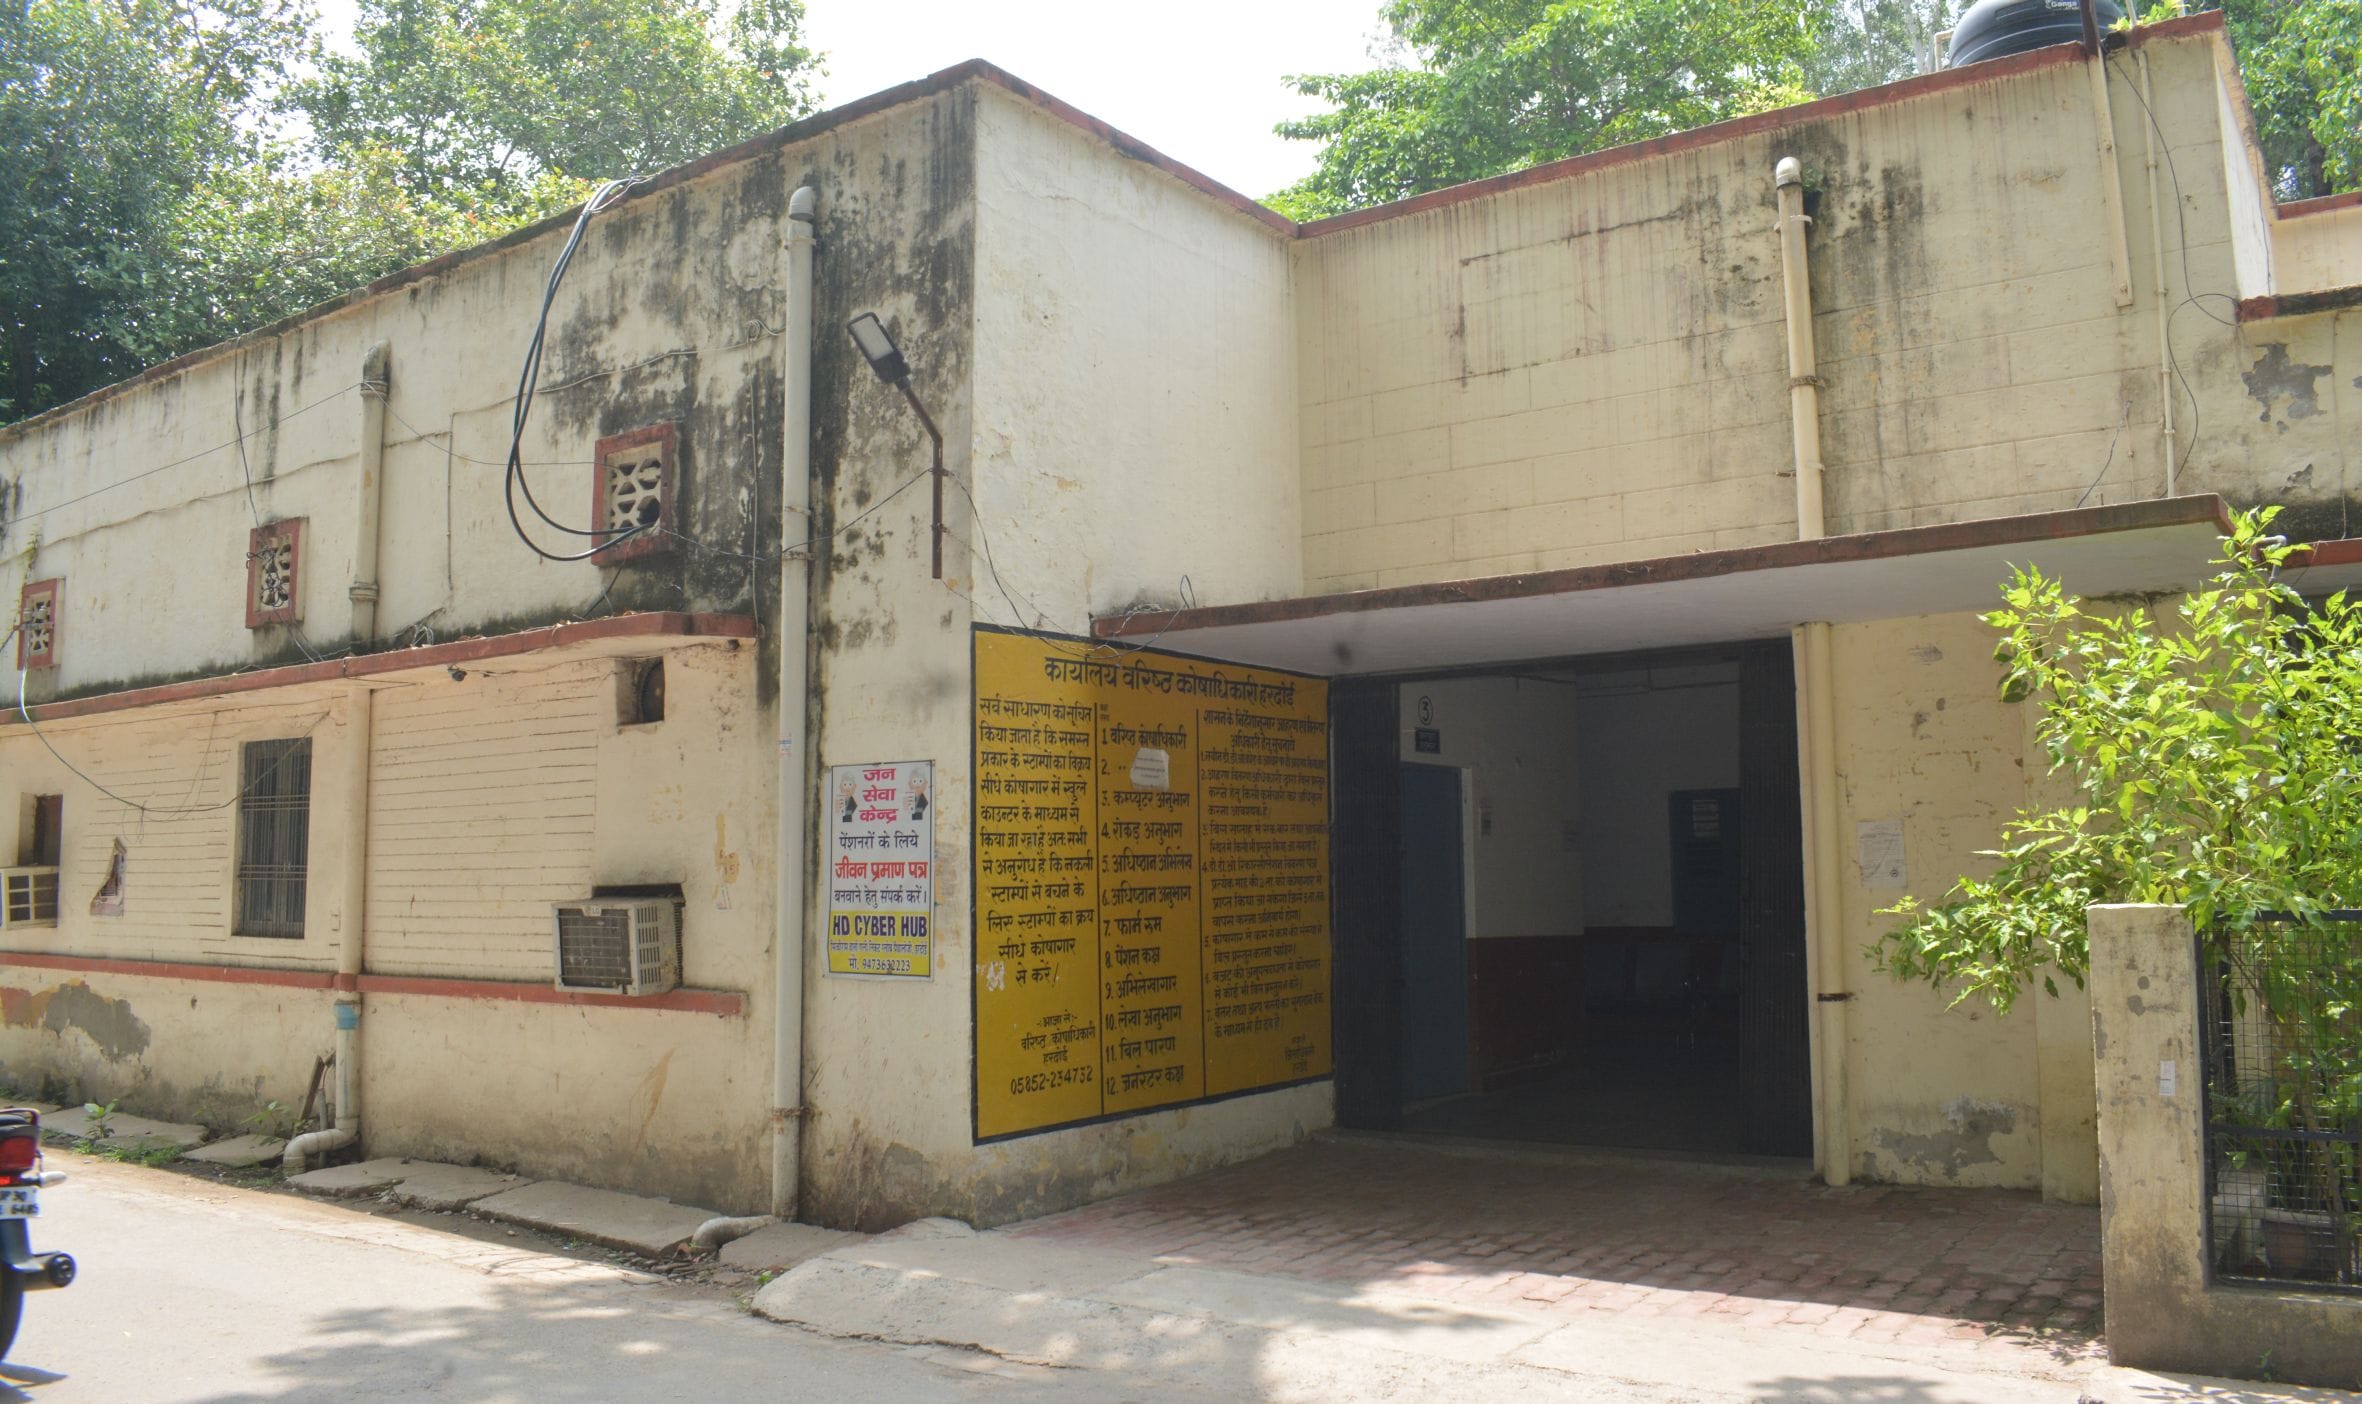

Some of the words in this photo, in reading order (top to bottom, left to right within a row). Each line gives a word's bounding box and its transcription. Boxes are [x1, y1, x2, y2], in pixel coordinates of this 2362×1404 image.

[1045, 654, 1120, 687] कार्यालय
[1176, 665, 1258, 705] कोषाधिकारी
[980, 693, 1001, 715] सर्व
[1003, 700, 1051, 720] साधारण
[1052, 698, 1064, 720] को
[980, 720, 1007, 742] किया
[1009, 728, 1030, 744] जाता
[1032, 721, 1040, 748] है
[1044, 724, 1057, 745] कि
[981, 750, 1008, 767] प्रकार
[1010, 748, 1020, 767] के
[1053, 756, 1065, 770] का
[863, 765, 896, 782] जन
[1004, 774, 1048, 796] कोषागार
[1051, 774, 1060, 796] में
[863, 785, 896, 802] सेवा
[859, 806, 898, 823] केन्द्र
[981, 806, 1019, 823] काउन्टर
[1021, 800, 1032, 821] के
[1035, 807, 1069, 821] माध्यम
[1071, 803, 1079, 823] से
[839, 832, 875, 851] पेंशनरों
[879, 831, 890, 849] के
[893, 830, 919, 849] लिये
[980, 825, 1006, 847] किया
[1008, 832, 1018, 847] जा
[1021, 833, 1037, 849] रहा
[835, 856, 867, 879] जीवन
[871, 862, 905, 882] प्रमाण
[909, 862, 928, 880] पत्र
[983, 852, 993, 875] से
[996, 853, 1035, 880] अनुरोध
[1038, 851, 1046, 875] है
[1050, 852, 1062, 872] कि
[834, 888, 861, 904] बनवाने
[865, 890, 878, 908] हेतु
[881, 885, 903, 904] संपर्क
[1032, 880, 1042, 900] से
[1074, 877, 1085, 896] के
[833, 915, 850, 936] HD
[855, 916, 895, 937] CYBER
[901, 916, 927, 937] HUB
[1060, 912, 1073, 926] का
[1031, 934, 1076, 957] कोषागार
[1016, 962, 1027, 987] से
[1011, 1066, 1093, 1095] 05852-234732
